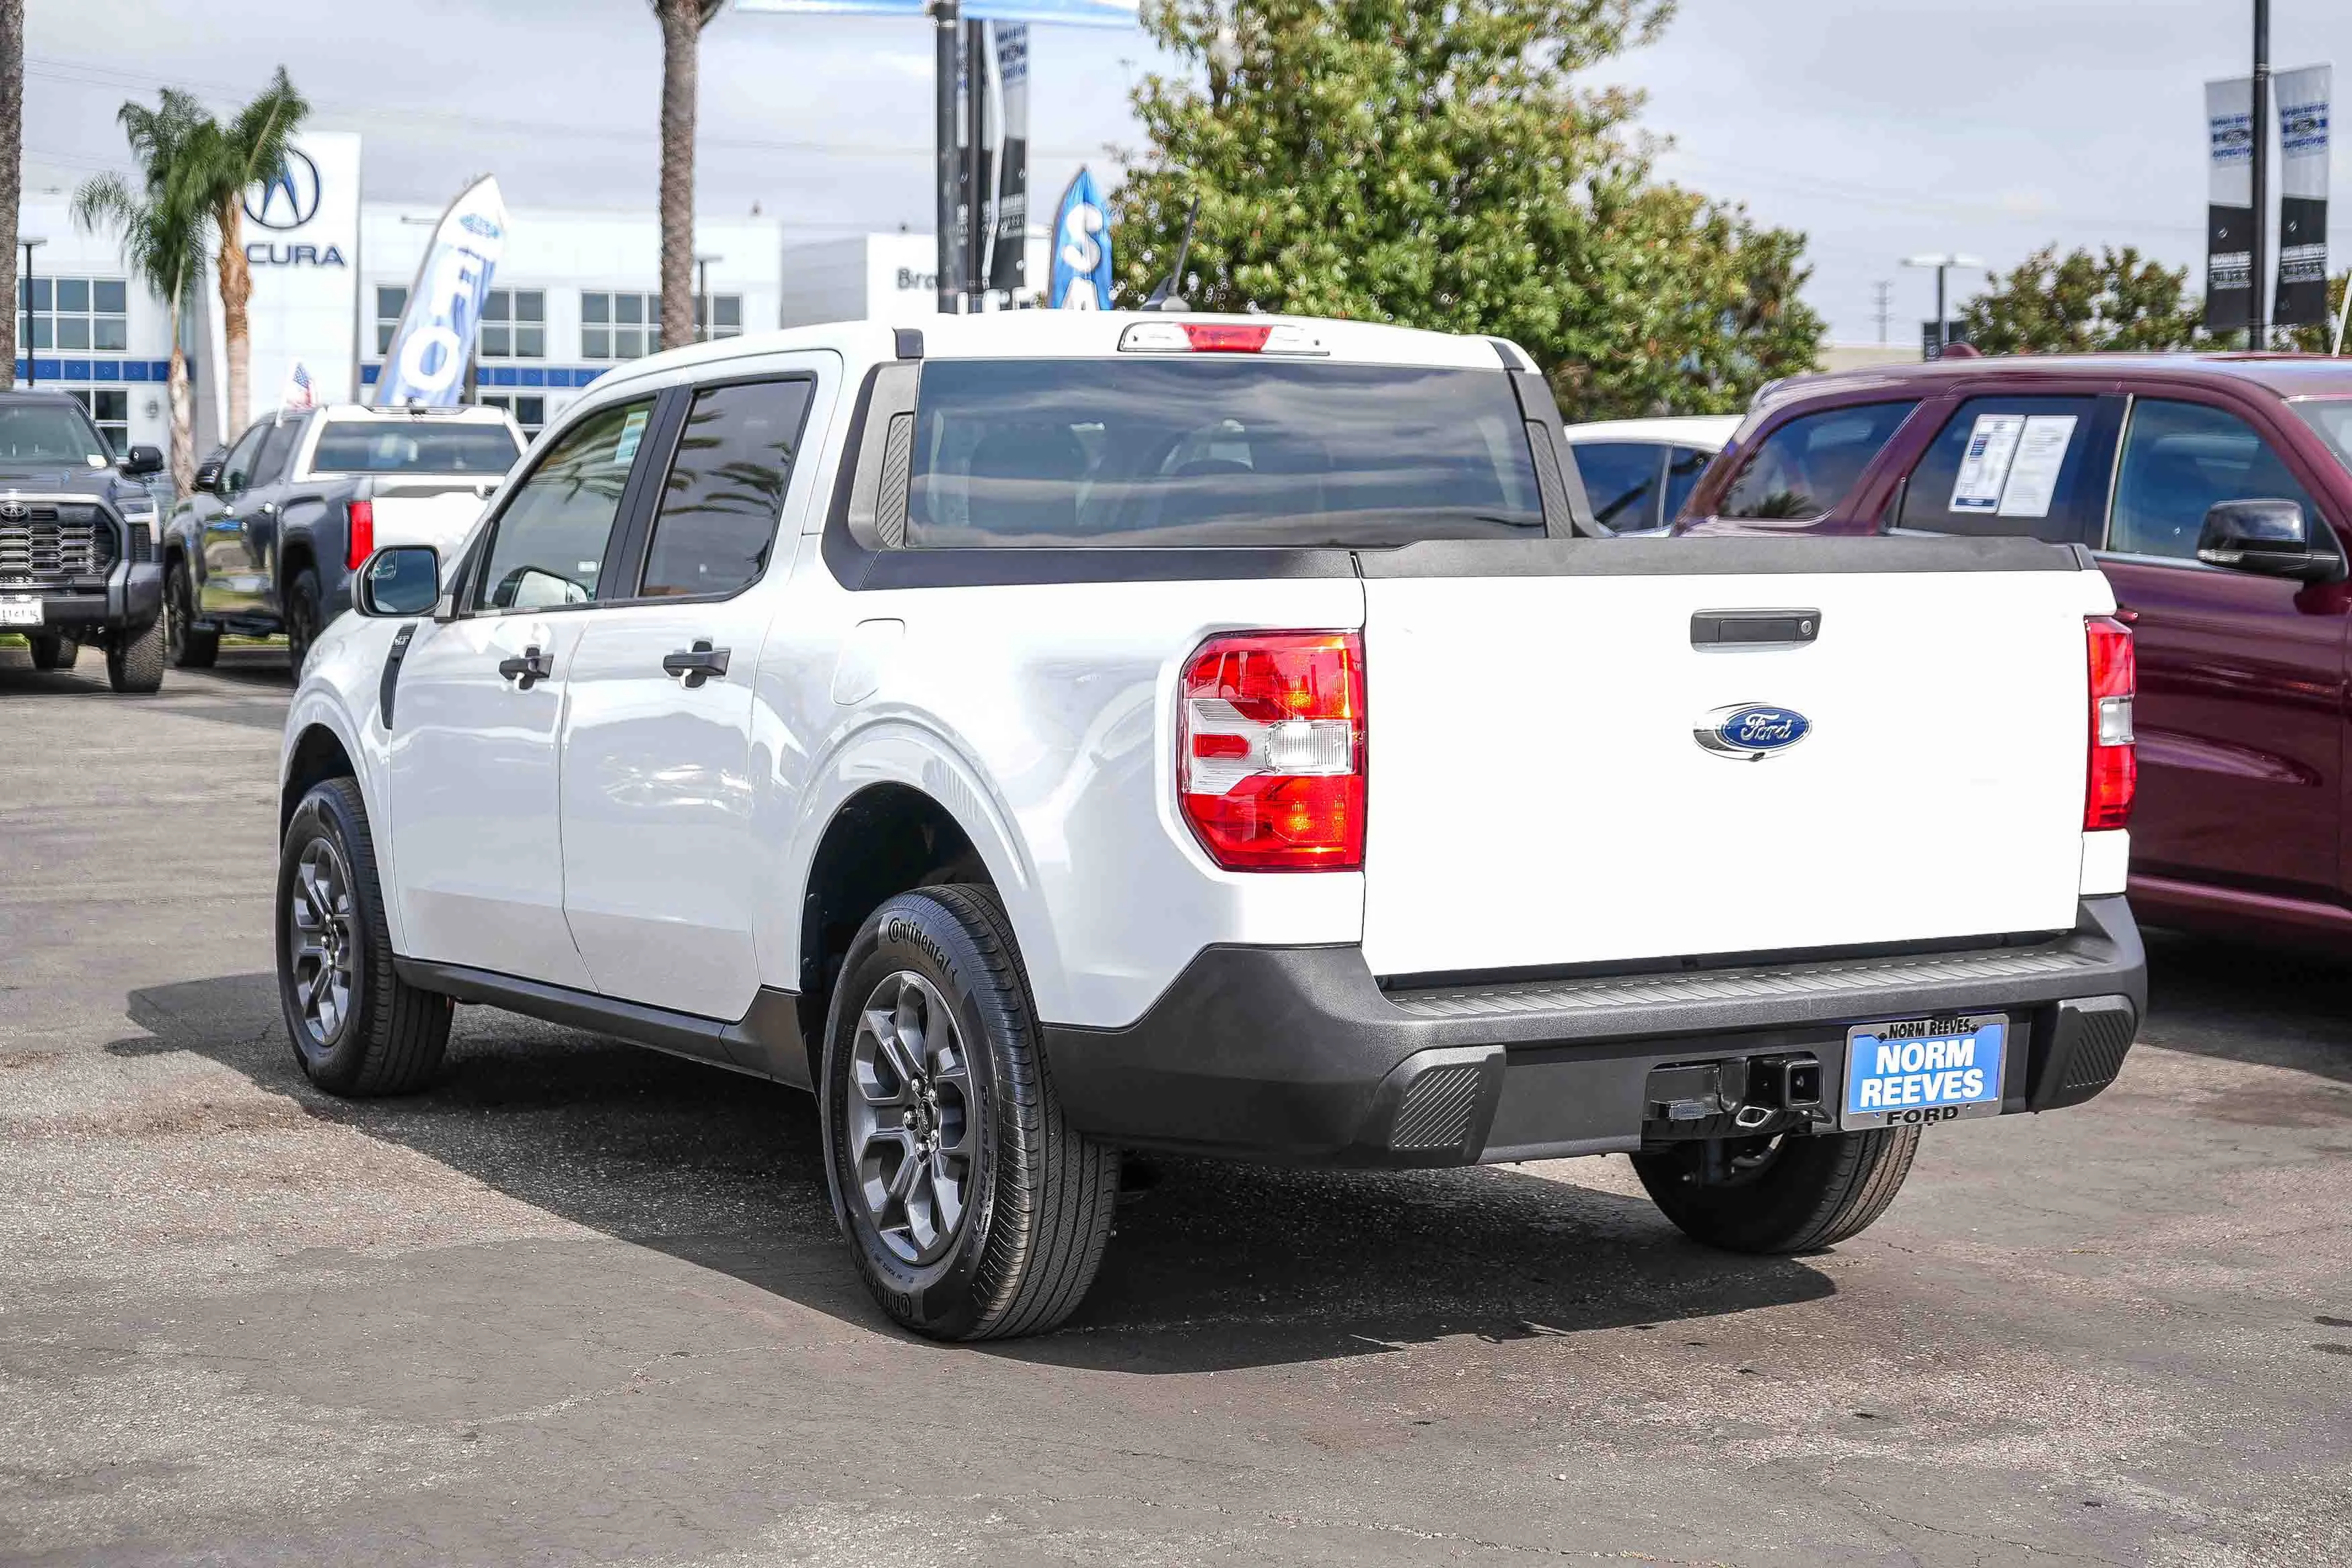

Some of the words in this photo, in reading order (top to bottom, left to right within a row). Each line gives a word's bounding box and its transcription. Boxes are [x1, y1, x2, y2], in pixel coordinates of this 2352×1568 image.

[246, 242, 346, 266] CURA
[898, 268, 938, 289] Bro
[399, 247, 483, 397] FO
[1741, 713, 1794, 740] Ford
[887, 917, 951, 977] Continental
[1889, 1024, 1925, 1038] NORM
[1929, 1018, 1969, 1035] REEVES
[1876, 1038, 1975, 1075] NORM
[1860, 1069, 1984, 1108] REEVES
[1887, 1106, 1959, 1125] FORD
